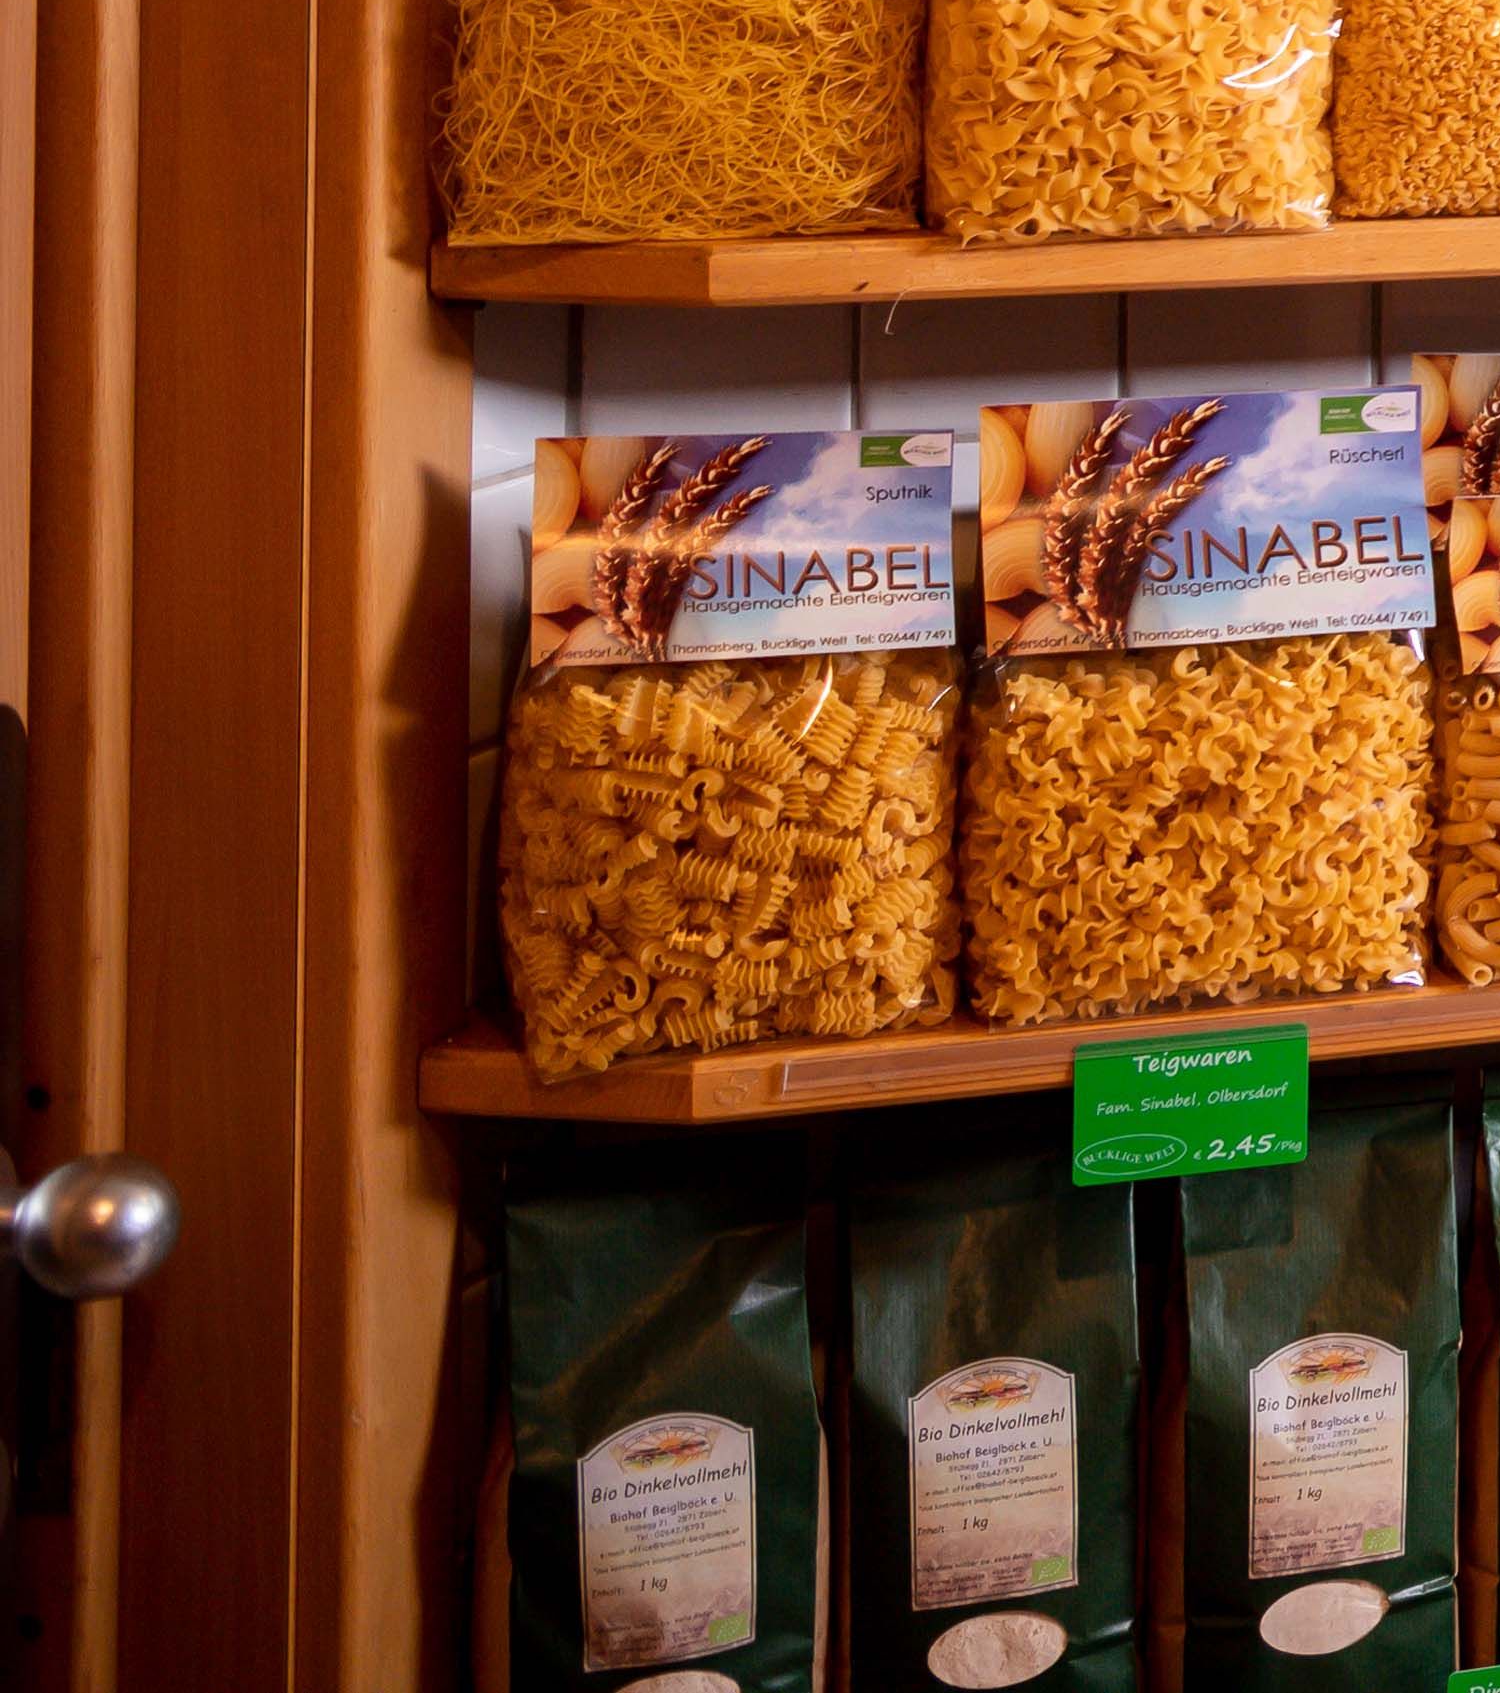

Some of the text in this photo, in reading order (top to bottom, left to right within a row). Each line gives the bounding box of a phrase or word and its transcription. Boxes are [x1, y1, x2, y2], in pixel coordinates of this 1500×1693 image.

[1329, 445, 1405, 464] Rüscherl
[866, 484, 932, 503] Sputnik
[1144, 515, 1424, 582] SINABEL
[688, 544, 950, 600] SINABEL
[1133, 1048, 1252, 1077] Teigwaren
[1097, 1102, 1133, 1116] Fam.
[1207, 1082, 1289, 1105] Olbersdorf
[591, 1461, 748, 1504] Bio Dinkelvollmehl
